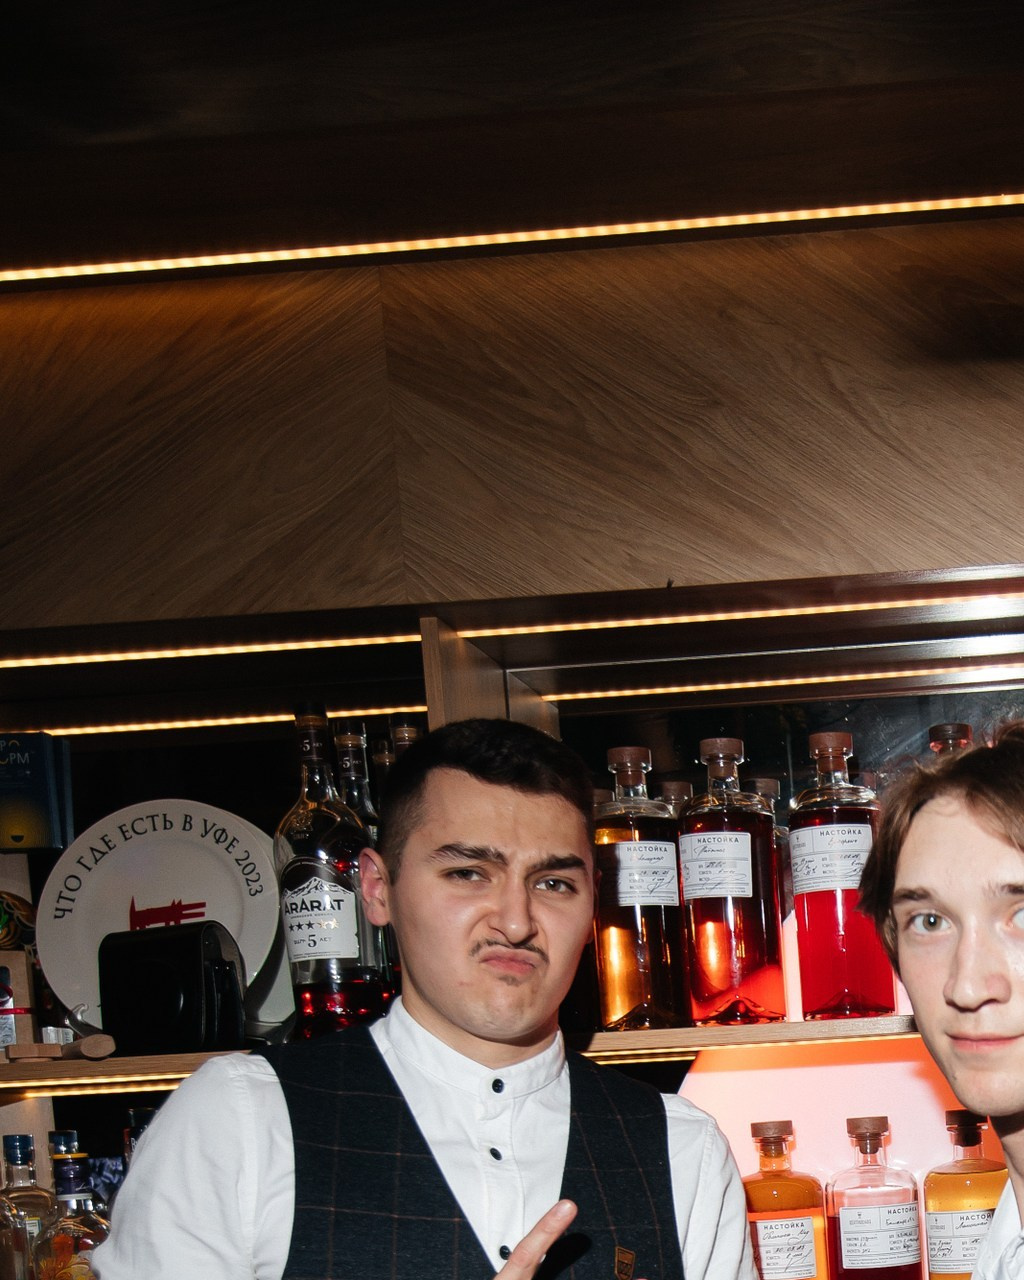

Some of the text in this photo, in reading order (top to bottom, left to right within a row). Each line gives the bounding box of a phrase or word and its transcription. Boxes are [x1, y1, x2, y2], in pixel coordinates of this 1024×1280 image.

[303, 740, 310, 751] 5
[342, 757, 350, 768] 5
[820, 828, 862, 836] НАСТОЙКА
[54, 813, 264, 920] ЧТО ГДЕ ЕСТЬ В УФЕ 2023
[284, 898, 345, 916] ARARAT
[307, 934, 317, 948] 5
[960, 1212, 994, 1221] НАСТОЙ
[763, 1222, 805, 1230] НАСТОЙКА
